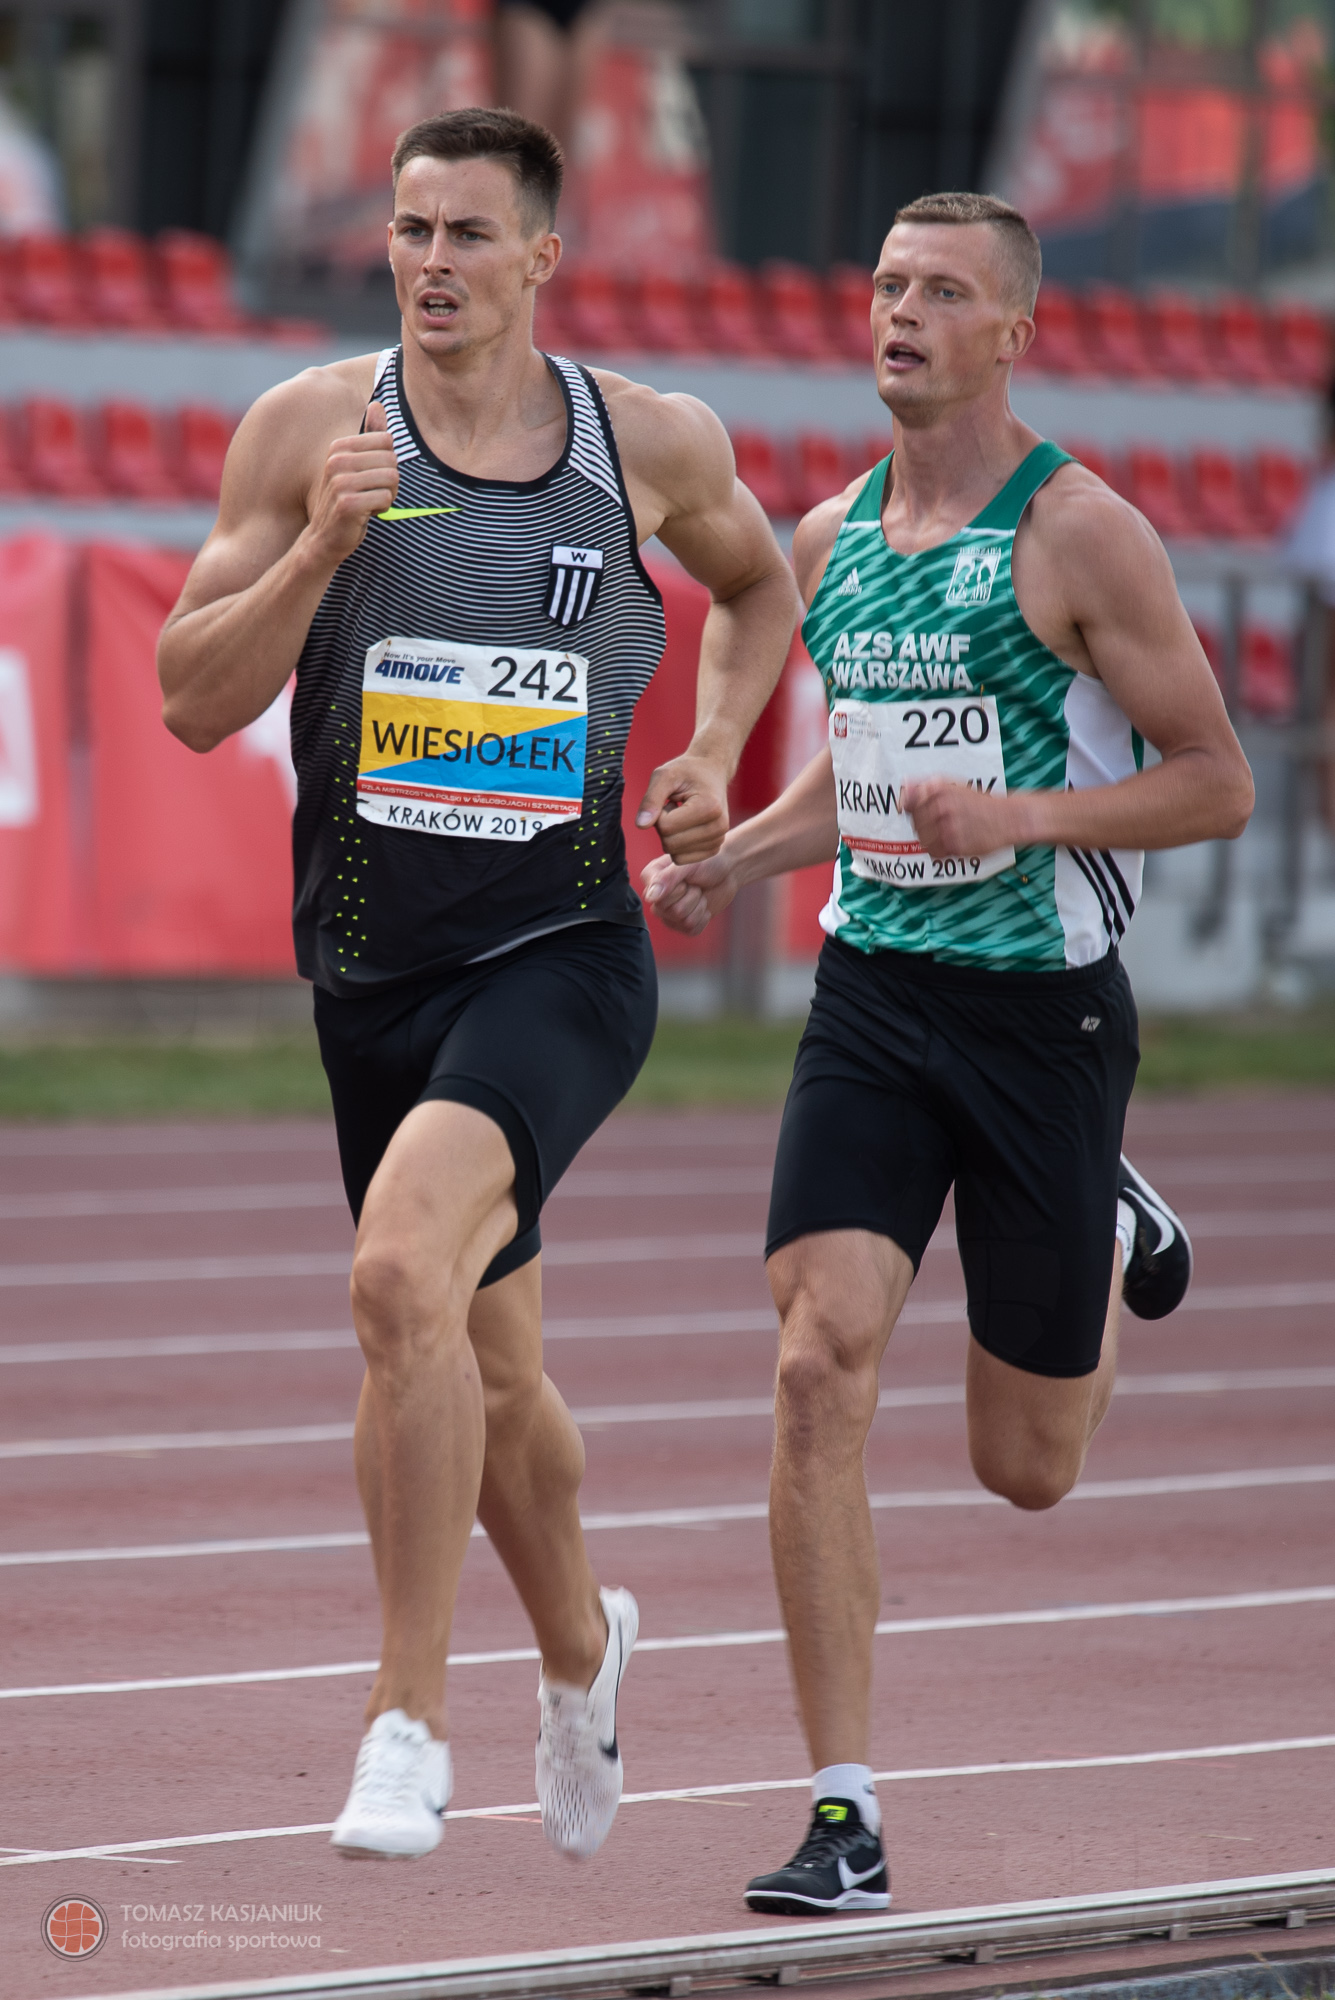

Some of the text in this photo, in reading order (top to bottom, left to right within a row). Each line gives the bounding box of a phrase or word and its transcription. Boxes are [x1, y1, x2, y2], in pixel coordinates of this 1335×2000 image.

[570, 551, 588, 563] W
[435, 656, 457, 664] Move
[832, 631, 971, 662] AZS AWF
[374, 659, 465, 685] 4MOVE
[487, 656, 579, 703] 242
[832, 660, 974, 692] WARSZAWA
[902, 704, 990, 749] 220
[371, 719, 578, 773] WIESIOŁEK
[361, 783, 381, 792] PZLA
[382, 786, 435, 799] MISTRZOSTWA
[435, 793, 462, 803] POLSKI
[472, 797, 528, 808] WIELOBOJACH
[531, 802, 579, 812] SZTAFETACH
[387, 804, 543, 836] KRAKÓW 2019
[863, 856, 981, 880] KRAKÓW 2019
